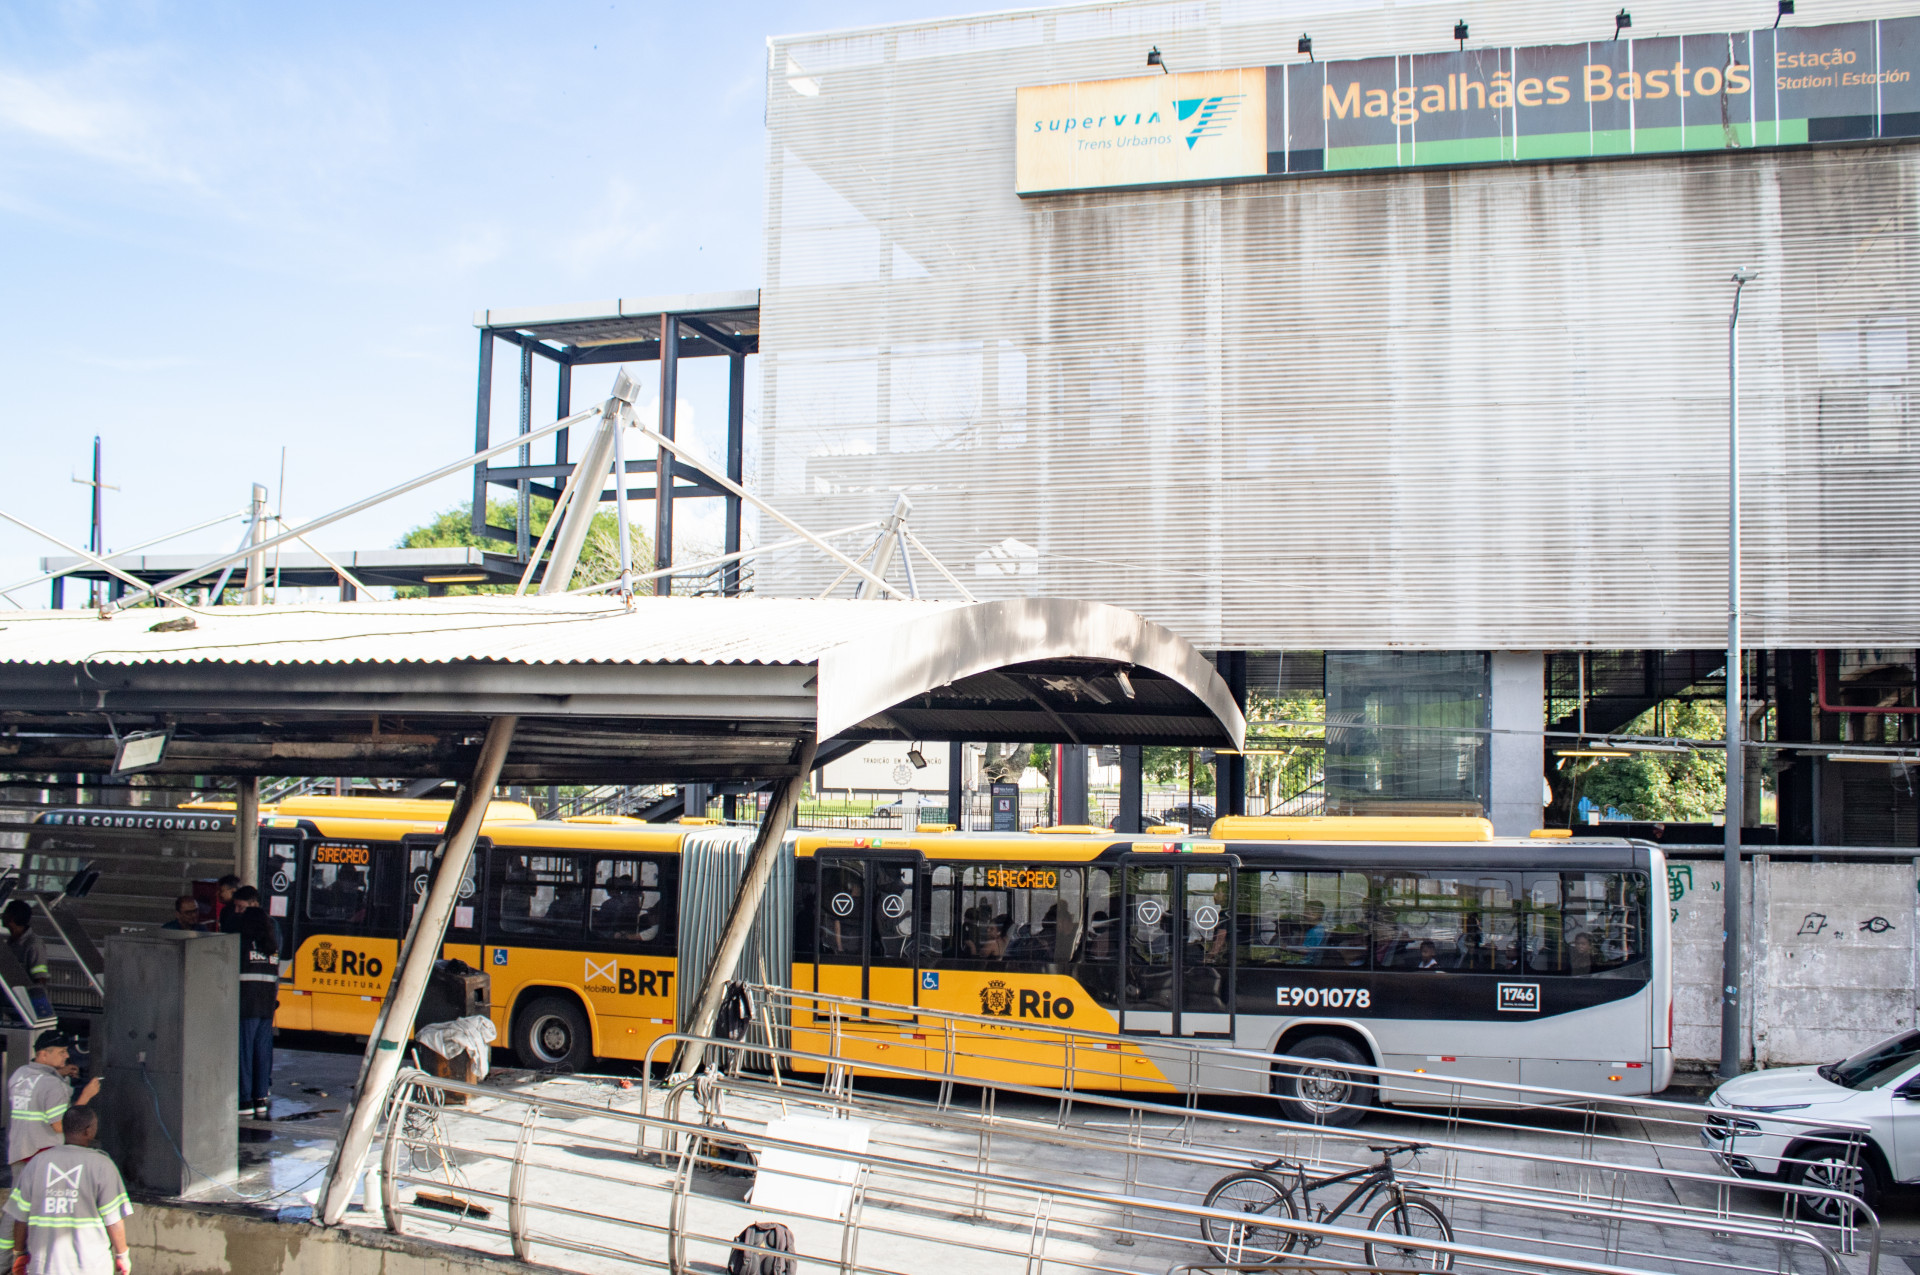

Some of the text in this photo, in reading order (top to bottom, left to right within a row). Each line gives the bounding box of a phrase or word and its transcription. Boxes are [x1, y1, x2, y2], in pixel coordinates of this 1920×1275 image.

[1776, 48, 1857, 70] Estação
[1776, 68, 1911, 90] Station Estación
[1322, 61, 1751, 126] Magalhães Bastos
[1077, 134, 1173, 151] Trens Urbanos
[91, 815, 222, 831] CONDICIONADO
[341, 949, 383, 978] Rio
[312, 977, 382, 990] PREFEITURA
[583, 984, 617, 994] MobiRIO
[618, 967, 675, 998] BRT
[1019, 988, 1075, 1020] Rio
[1276, 986, 1371, 1009] E901078
[1502, 987, 1536, 1002] 1746
[44, 1196, 79, 1214] BRT
